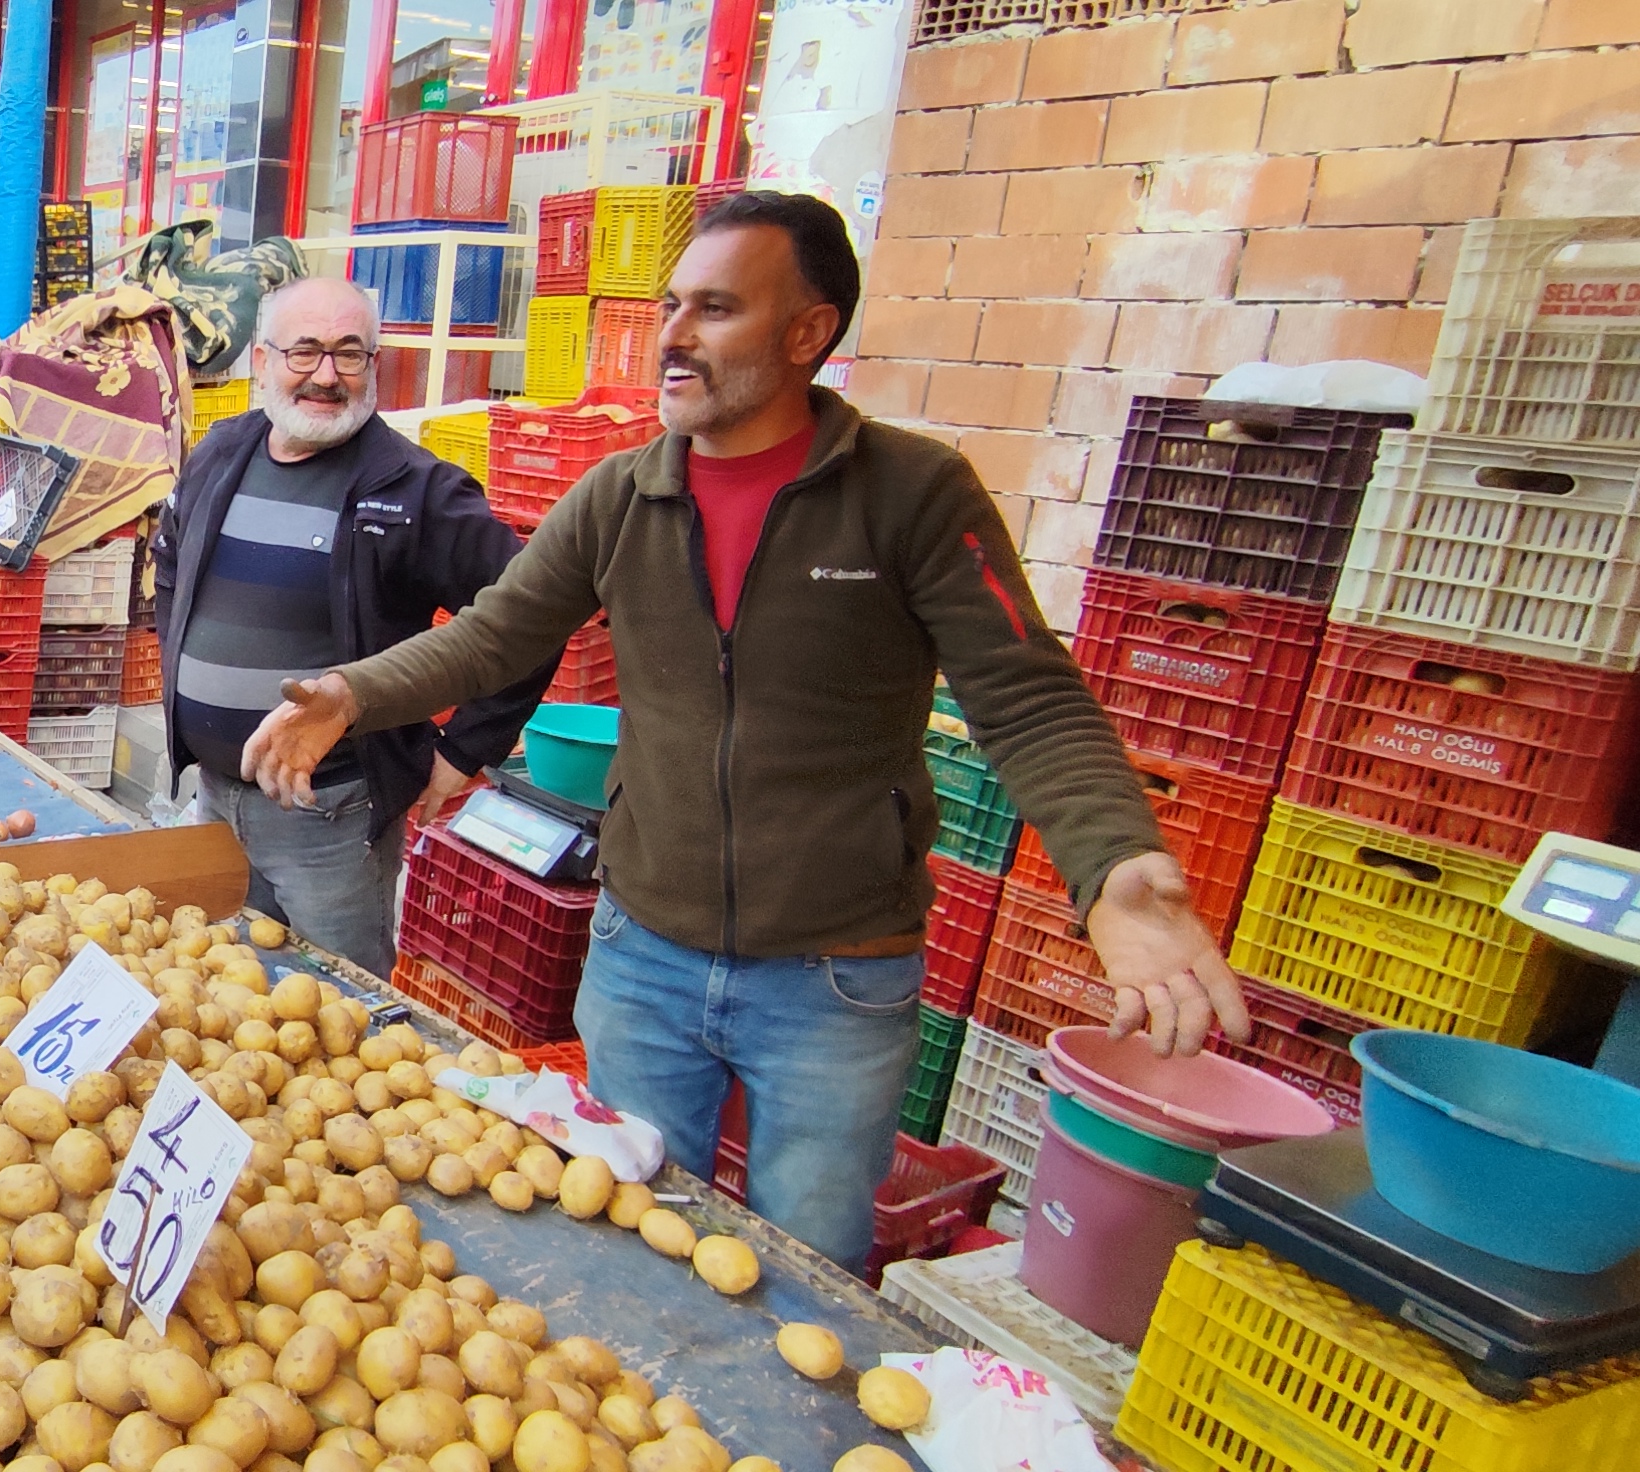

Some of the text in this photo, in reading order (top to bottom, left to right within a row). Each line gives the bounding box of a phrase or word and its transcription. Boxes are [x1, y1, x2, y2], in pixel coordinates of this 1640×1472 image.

[822, 567, 876, 580] Columbia
[1393, 722, 1495, 755] HACI OĞLU
[1430, 745, 1502, 775] ÖDEMİŞ
[1051, 968, 1085, 990] HACI
[1281, 1069, 1321, 1093] HACI
[148, 1095, 201, 1174] 4
